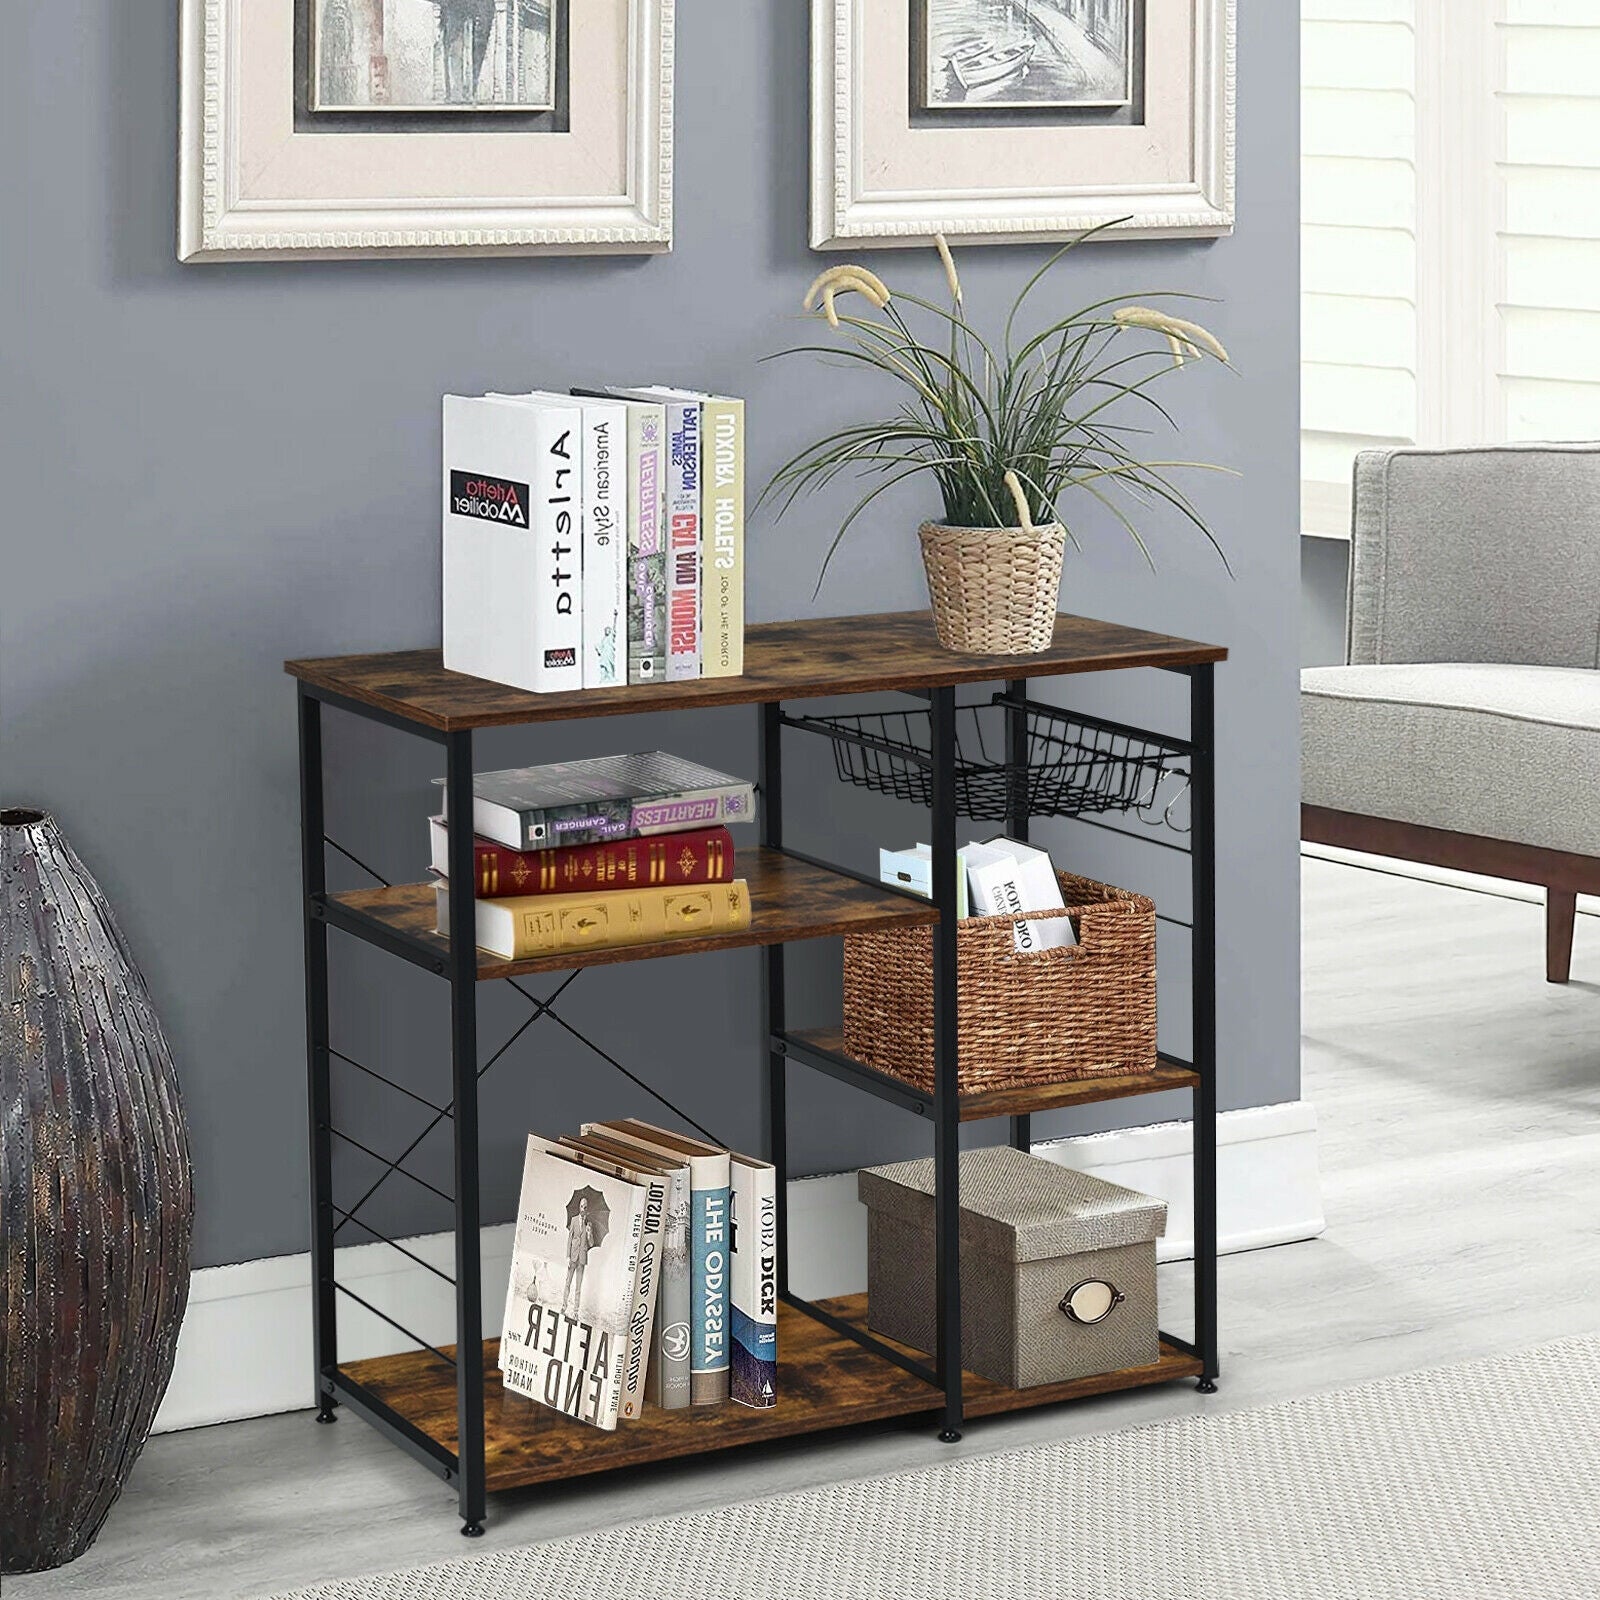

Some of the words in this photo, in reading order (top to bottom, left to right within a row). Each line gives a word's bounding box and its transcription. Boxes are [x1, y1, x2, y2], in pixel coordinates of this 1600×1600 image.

[635, 801, 714, 826] HEARTLESS
[556, 817, 607, 832] CARRIGER
[602, 821, 626, 832] GAIL
